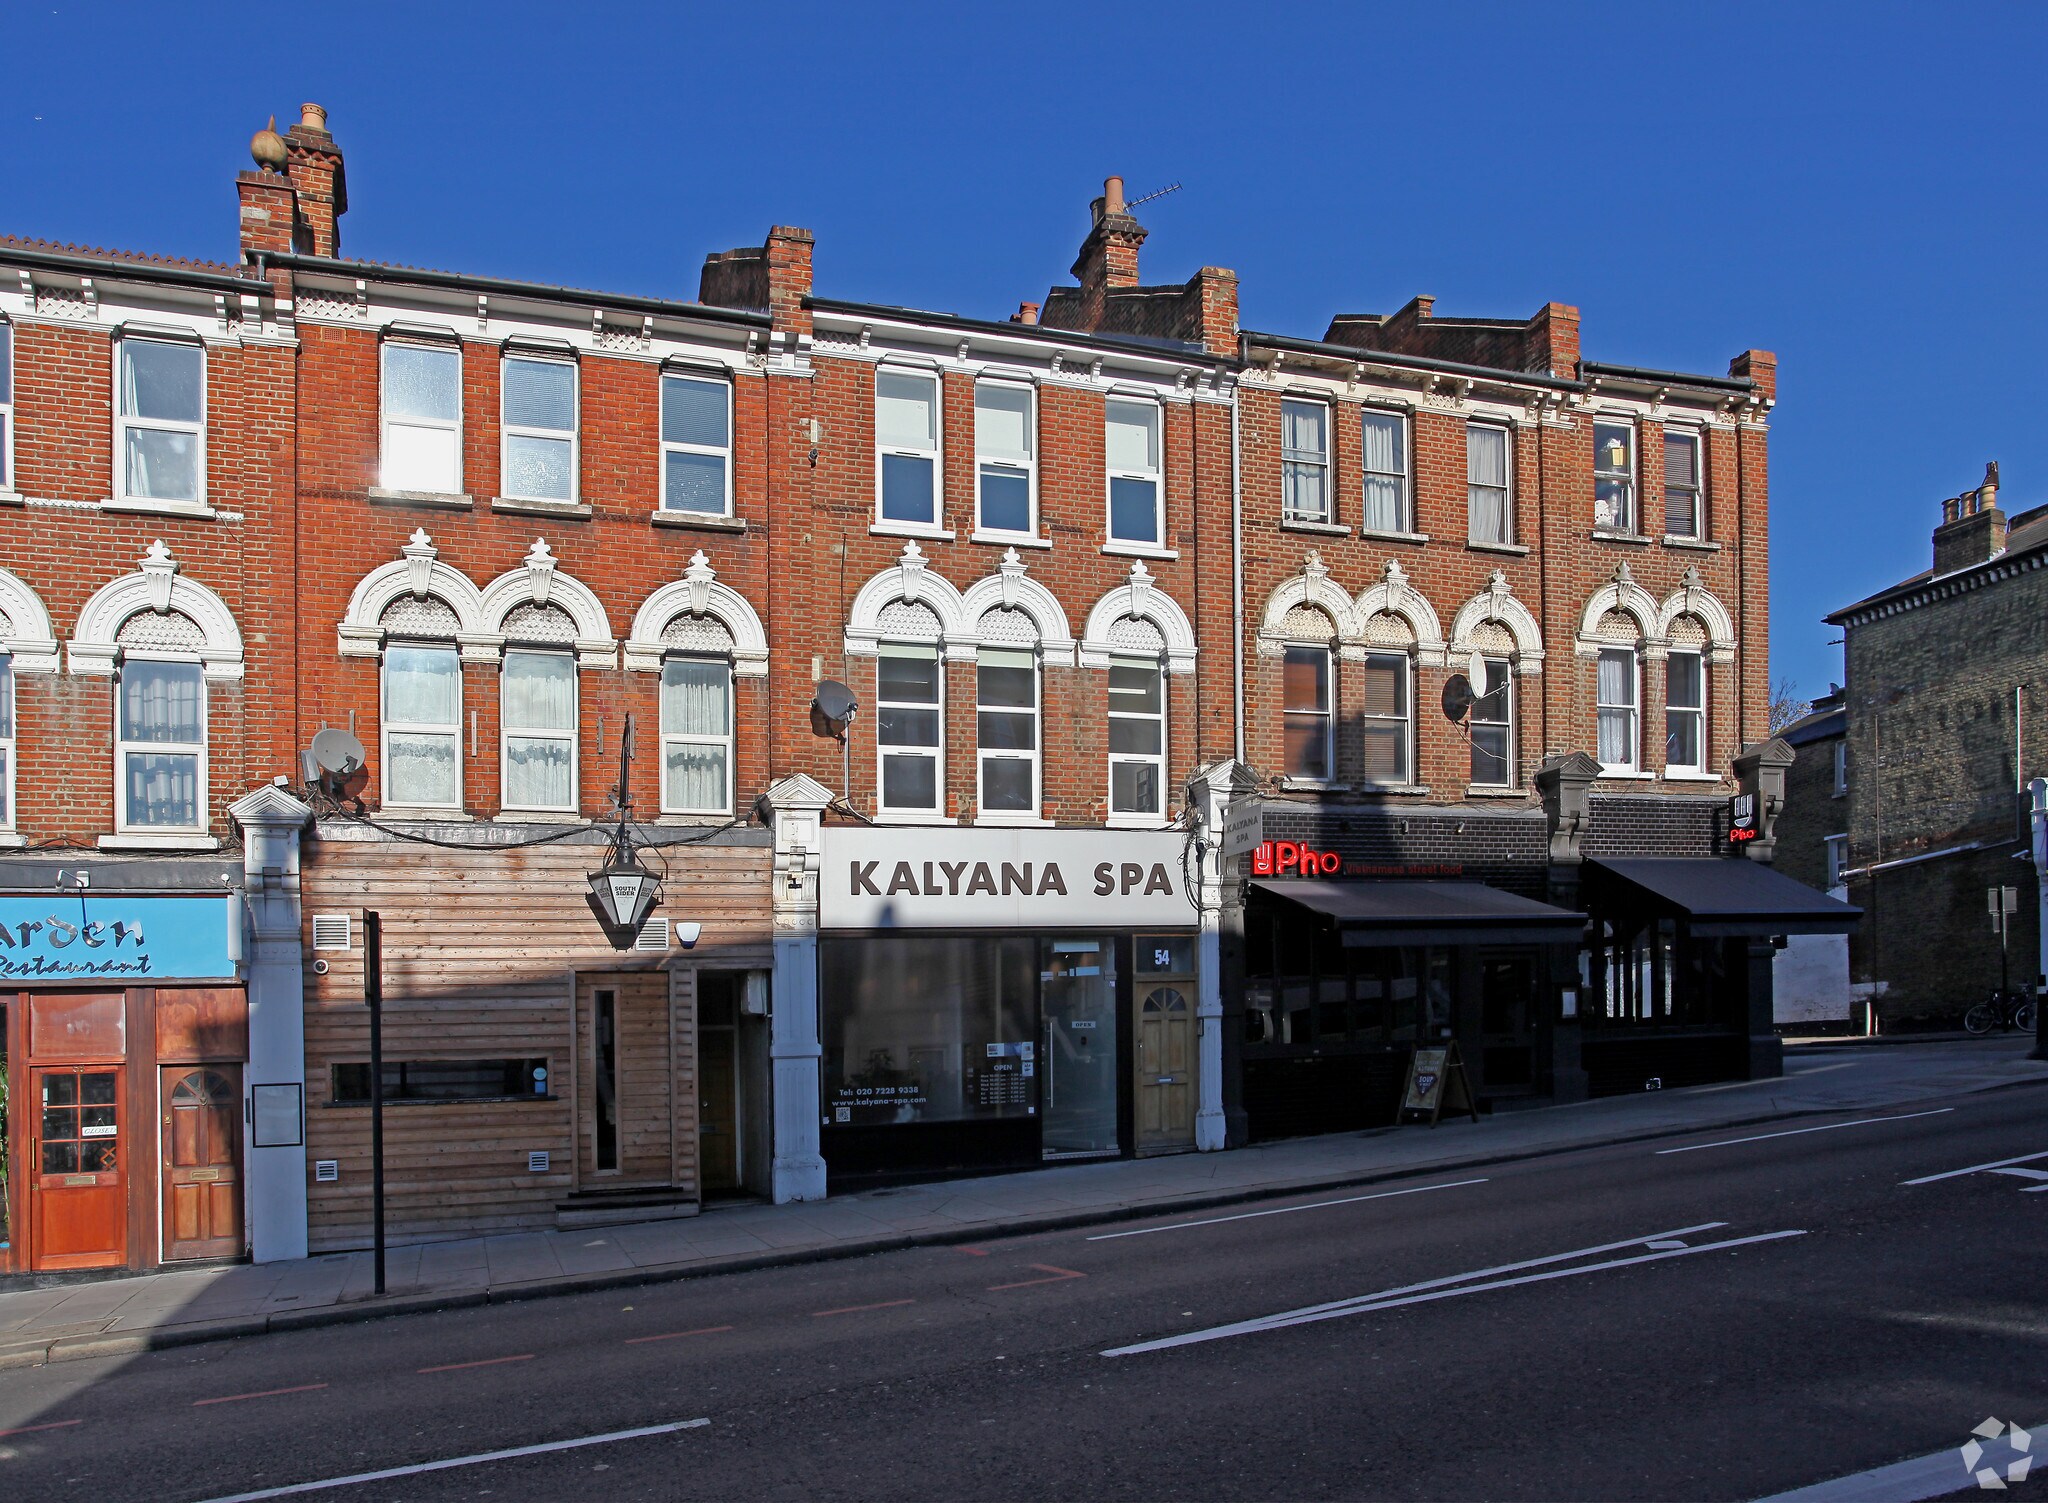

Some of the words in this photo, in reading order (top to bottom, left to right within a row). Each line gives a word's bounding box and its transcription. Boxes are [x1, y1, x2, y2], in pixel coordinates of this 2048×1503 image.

[1226, 816, 1259, 834] KALYANA
[1236, 832, 1249, 844] SPA
[1275, 841, 1341, 875] Pho
[1346, 863, 1404, 874] Vietnamese
[1408, 864, 1437, 874] street
[1440, 864, 1463, 874] food
[850, 861, 1068, 896] KALYANA
[1093, 862, 1174, 896] SPA
[1154, 949, 1170, 965] 54
[898, 1086, 919, 1094] 9338
[832, 1097, 927, 1107] www.kalyana-spa.com
[84, 1127, 116, 1135] CLOSED
